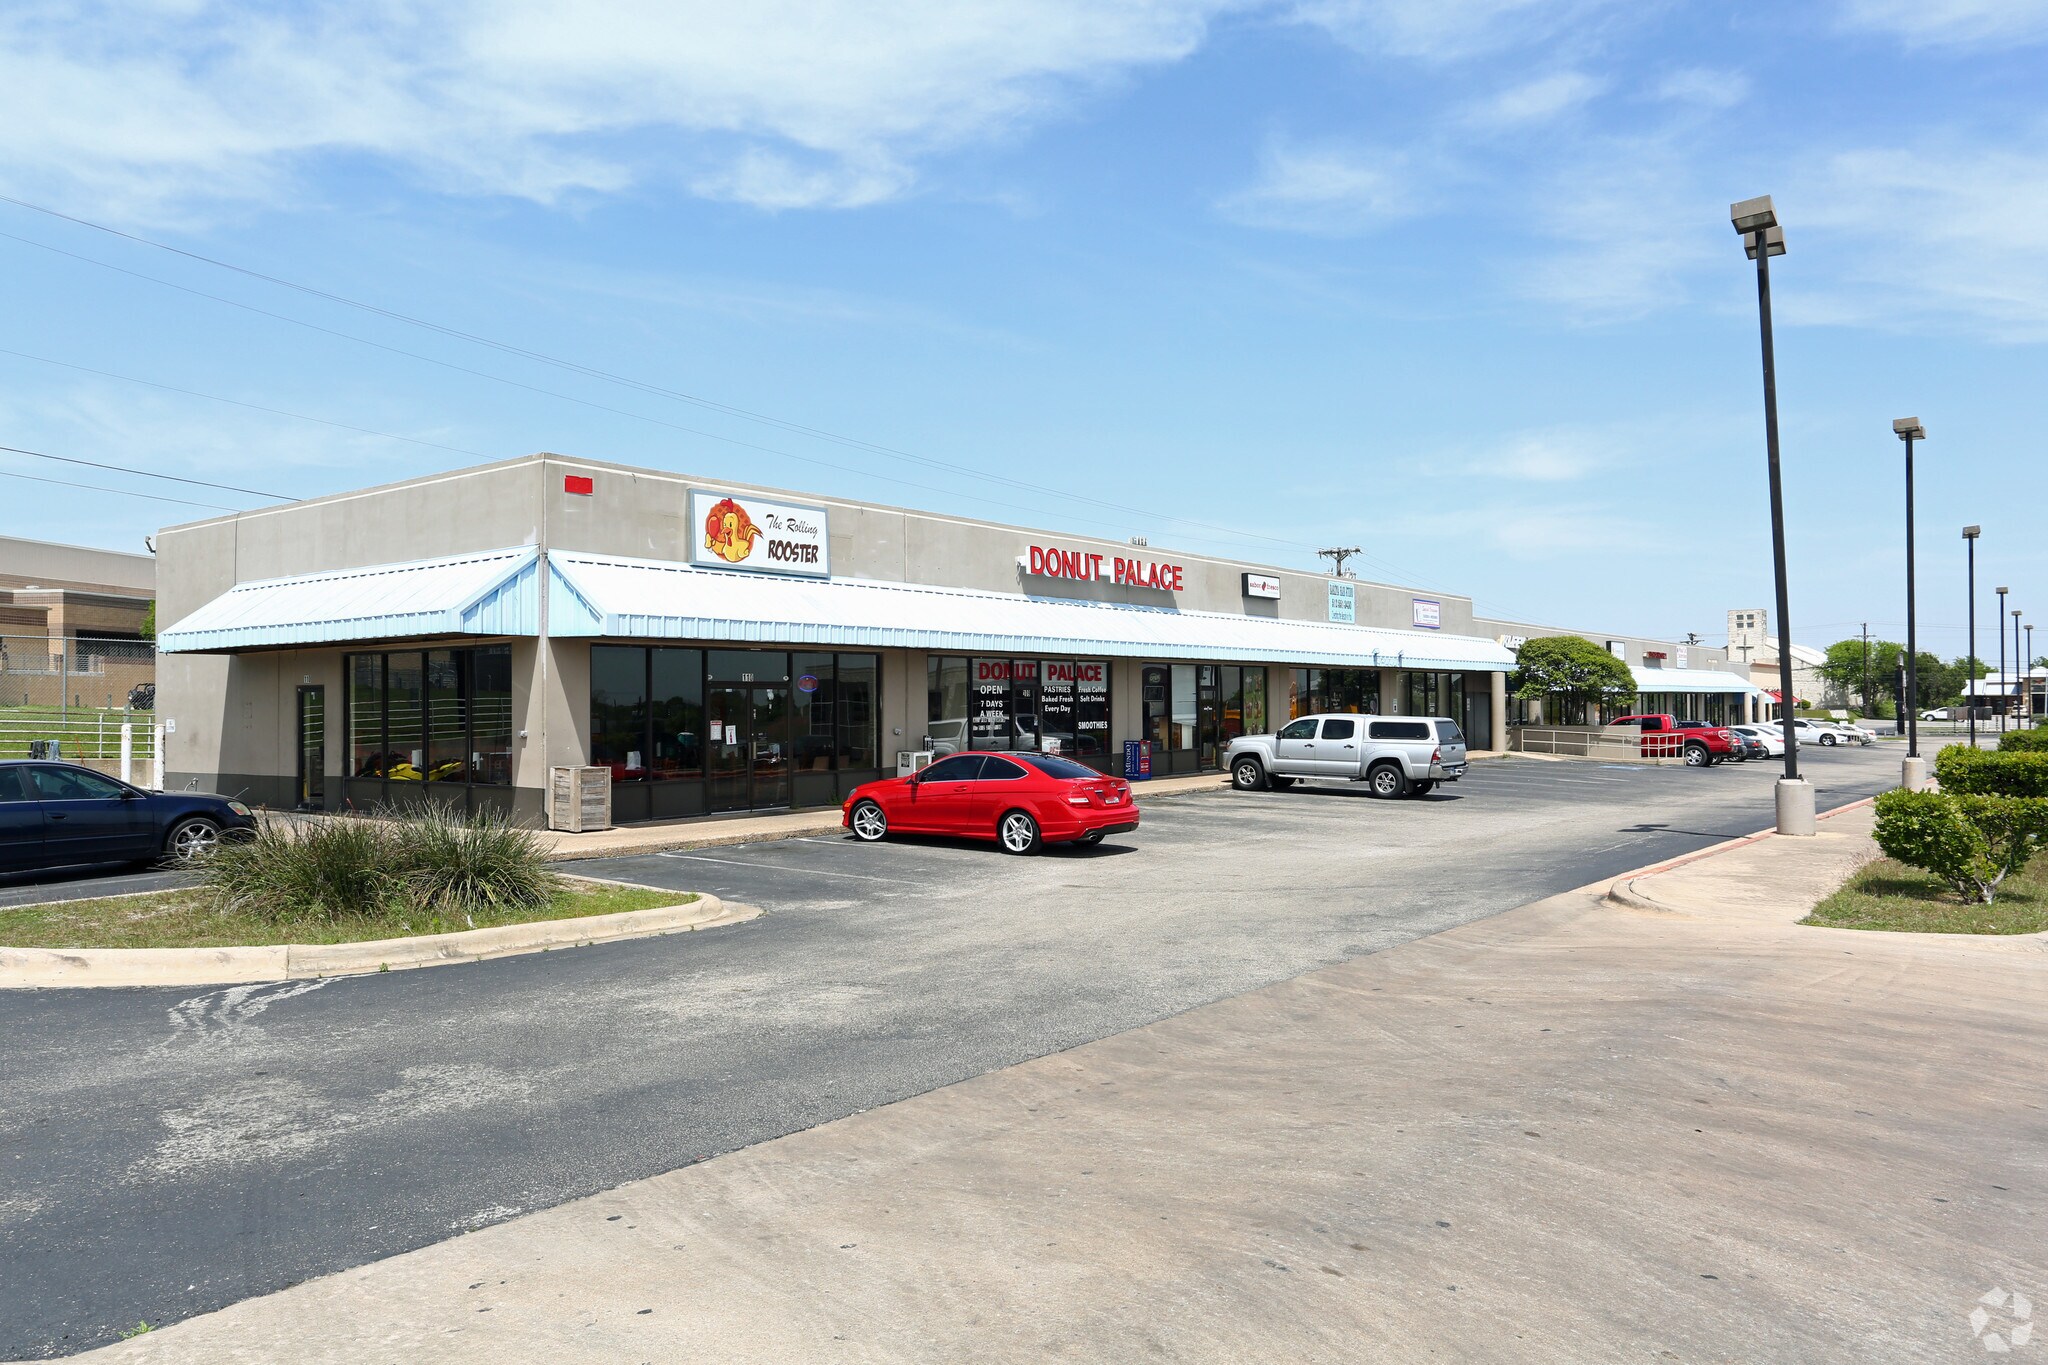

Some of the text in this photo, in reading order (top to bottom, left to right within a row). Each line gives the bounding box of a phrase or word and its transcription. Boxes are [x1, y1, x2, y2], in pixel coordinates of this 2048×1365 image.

[765, 513, 818, 539] The Rolling
[767, 539, 819, 564] ROOSTER
[1027, 545, 1184, 592] DONUT PALACE
[978, 662, 1103, 682] DONUT PALACE
[980, 685, 1003, 695] OPEN
[980, 700, 1004, 708] 7 DAYS
[1044, 704, 1071, 713] Every Day
[980, 710, 1004, 718] A WEEK
[1077, 720, 1108, 730] SMOOTHIES
